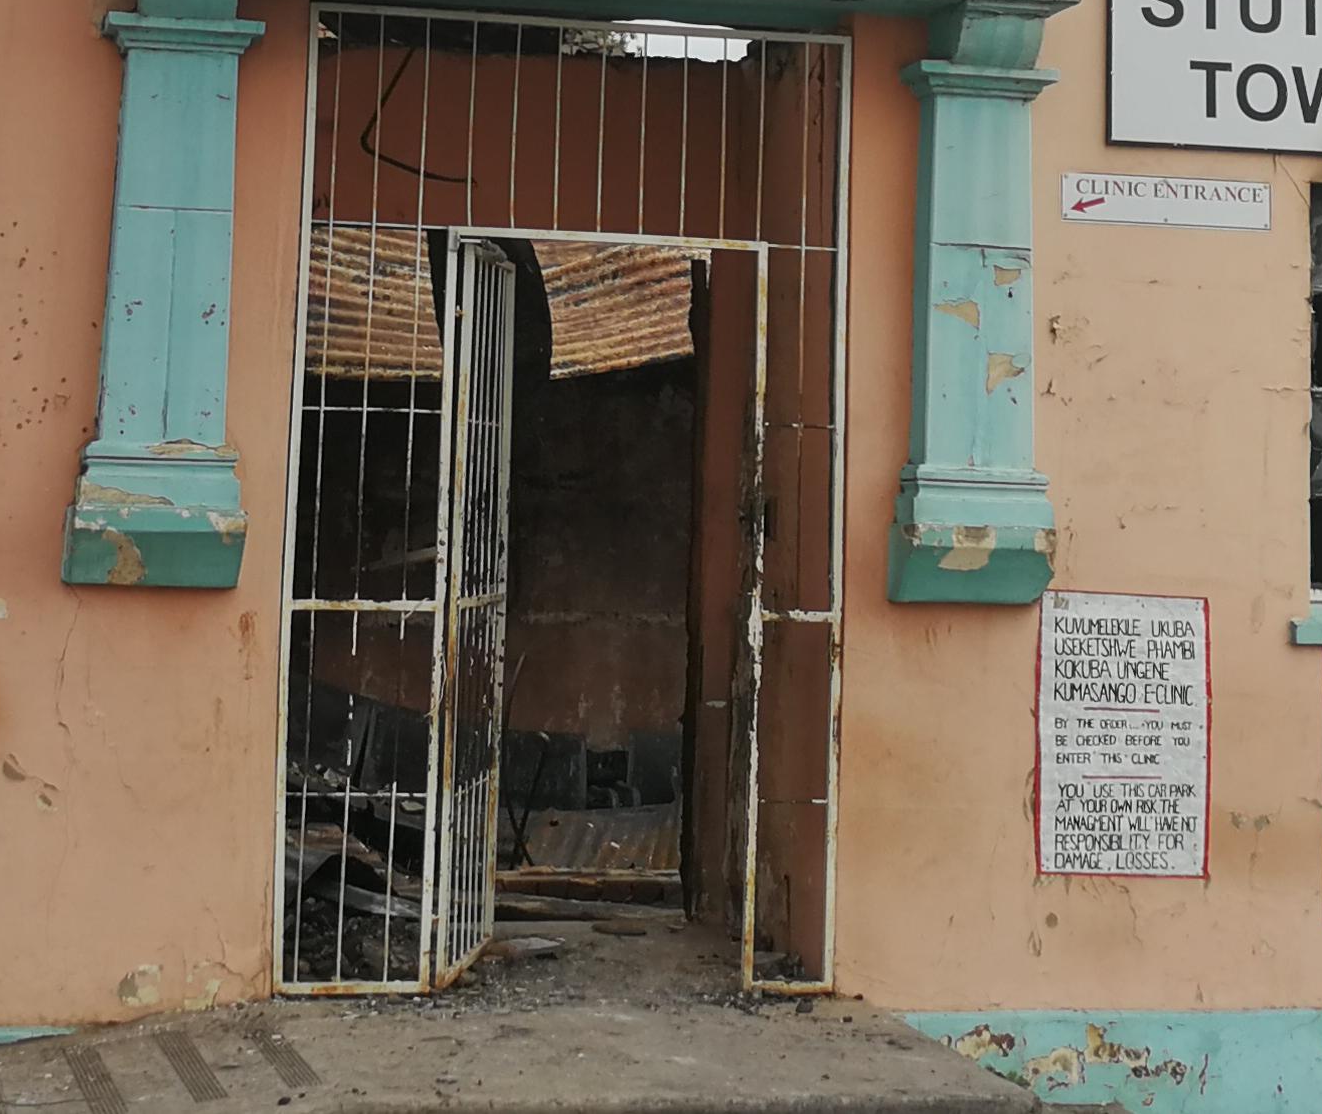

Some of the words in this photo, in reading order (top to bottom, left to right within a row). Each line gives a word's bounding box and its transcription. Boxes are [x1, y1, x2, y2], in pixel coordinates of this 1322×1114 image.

[1076, 178, 1147, 197] CLINIC
[1154, 183, 1264, 203] ENTRANCE
[1054, 616, 1141, 636] KUVUMELEKILE
[1151, 620, 1195, 637] UKUBA
[1054, 637, 1136, 658] USEKETSHWE
[1147, 639, 1195, 659] PHAMBI
[1054, 659, 1112, 679] KOKUBA
[1117, 661, 1170, 681] UNGENE
[1053, 682, 1136, 703] KUMASANGO
[1054, 717, 1068, 729] BY
[1077, 718, 1094, 729] THE
[1146, 720, 1163, 731] YOU
[1171, 721, 1192, 731] MUST
[1055, 735, 1068, 747] BE
[1076, 734, 1116, 746] CHECKED
[1125, 734, 1162, 746] BEFORE
[1173, 736, 1190, 746] YOU
[1056, 752, 1091, 764] ENTER
[1100, 753, 1122, 764] THIS
[1131, 753, 1160, 765] CLINIC
[1058, 783, 1084, 798] YOU
[1093, 784, 1114, 798] USE
[1120, 784, 1145, 798] THIS
[1148, 784, 1167, 798] CAR
[1169, 784, 1197, 798] PARK
[1056, 799, 1074, 813] AT
[1080, 799, 1107, 813] YOUR
[1110, 799, 1133, 814] OWN
[1160, 799, 1180, 814] THE
[1128, 816, 1151, 832] WILL
[1154, 816, 1180, 832] HAVE
[1181, 816, 1198, 833] NOT
[1158, 834, 1184, 851] FOR
